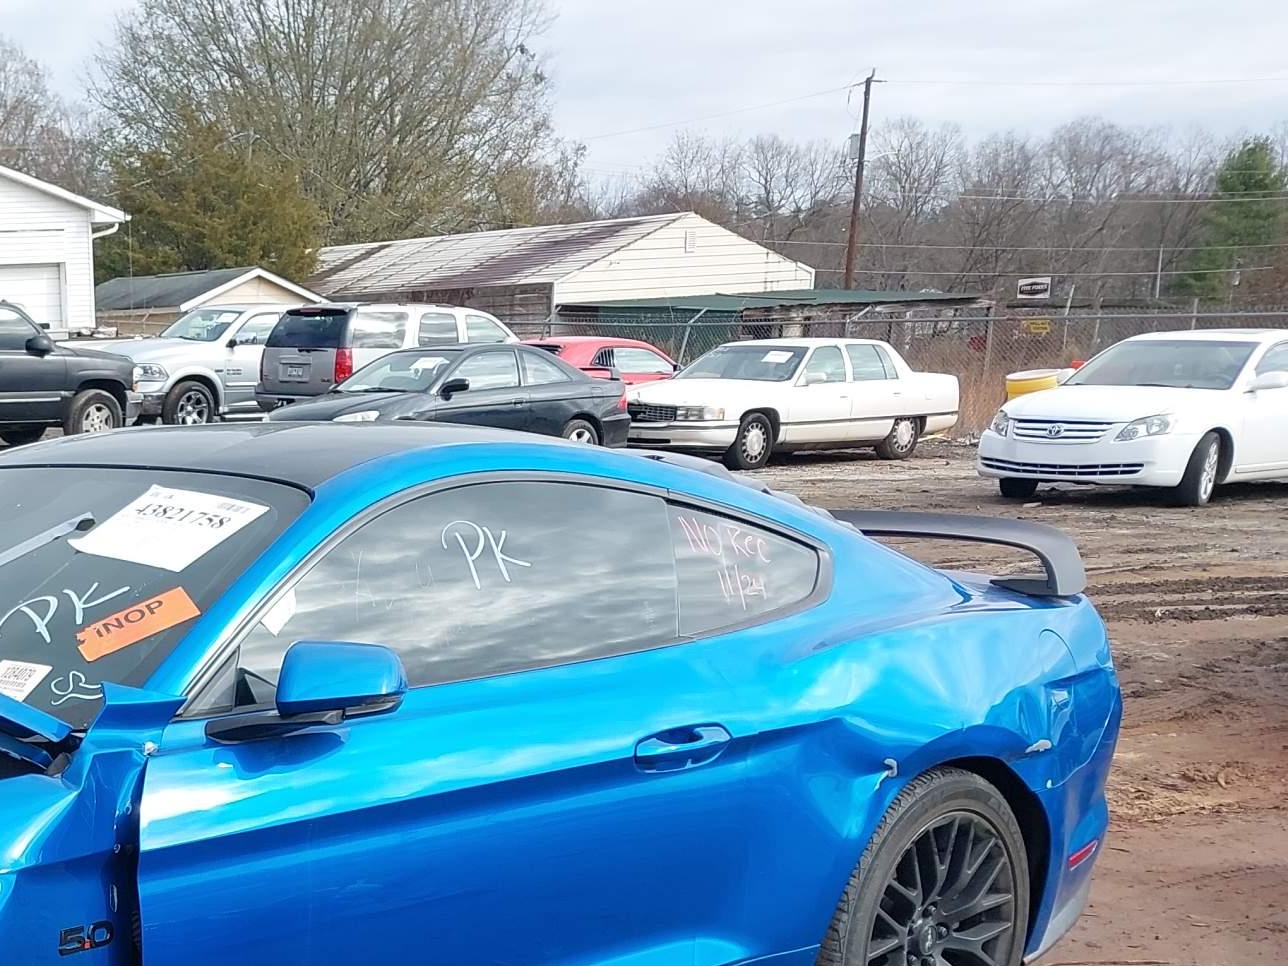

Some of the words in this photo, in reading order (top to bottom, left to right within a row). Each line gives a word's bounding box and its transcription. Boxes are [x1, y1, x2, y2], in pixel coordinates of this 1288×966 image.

[136, 503, 232, 530] 43821758
[441, 520, 531, 589] PK
[678, 516, 722, 556] NO
[58, 920, 114, 956] 5.0
